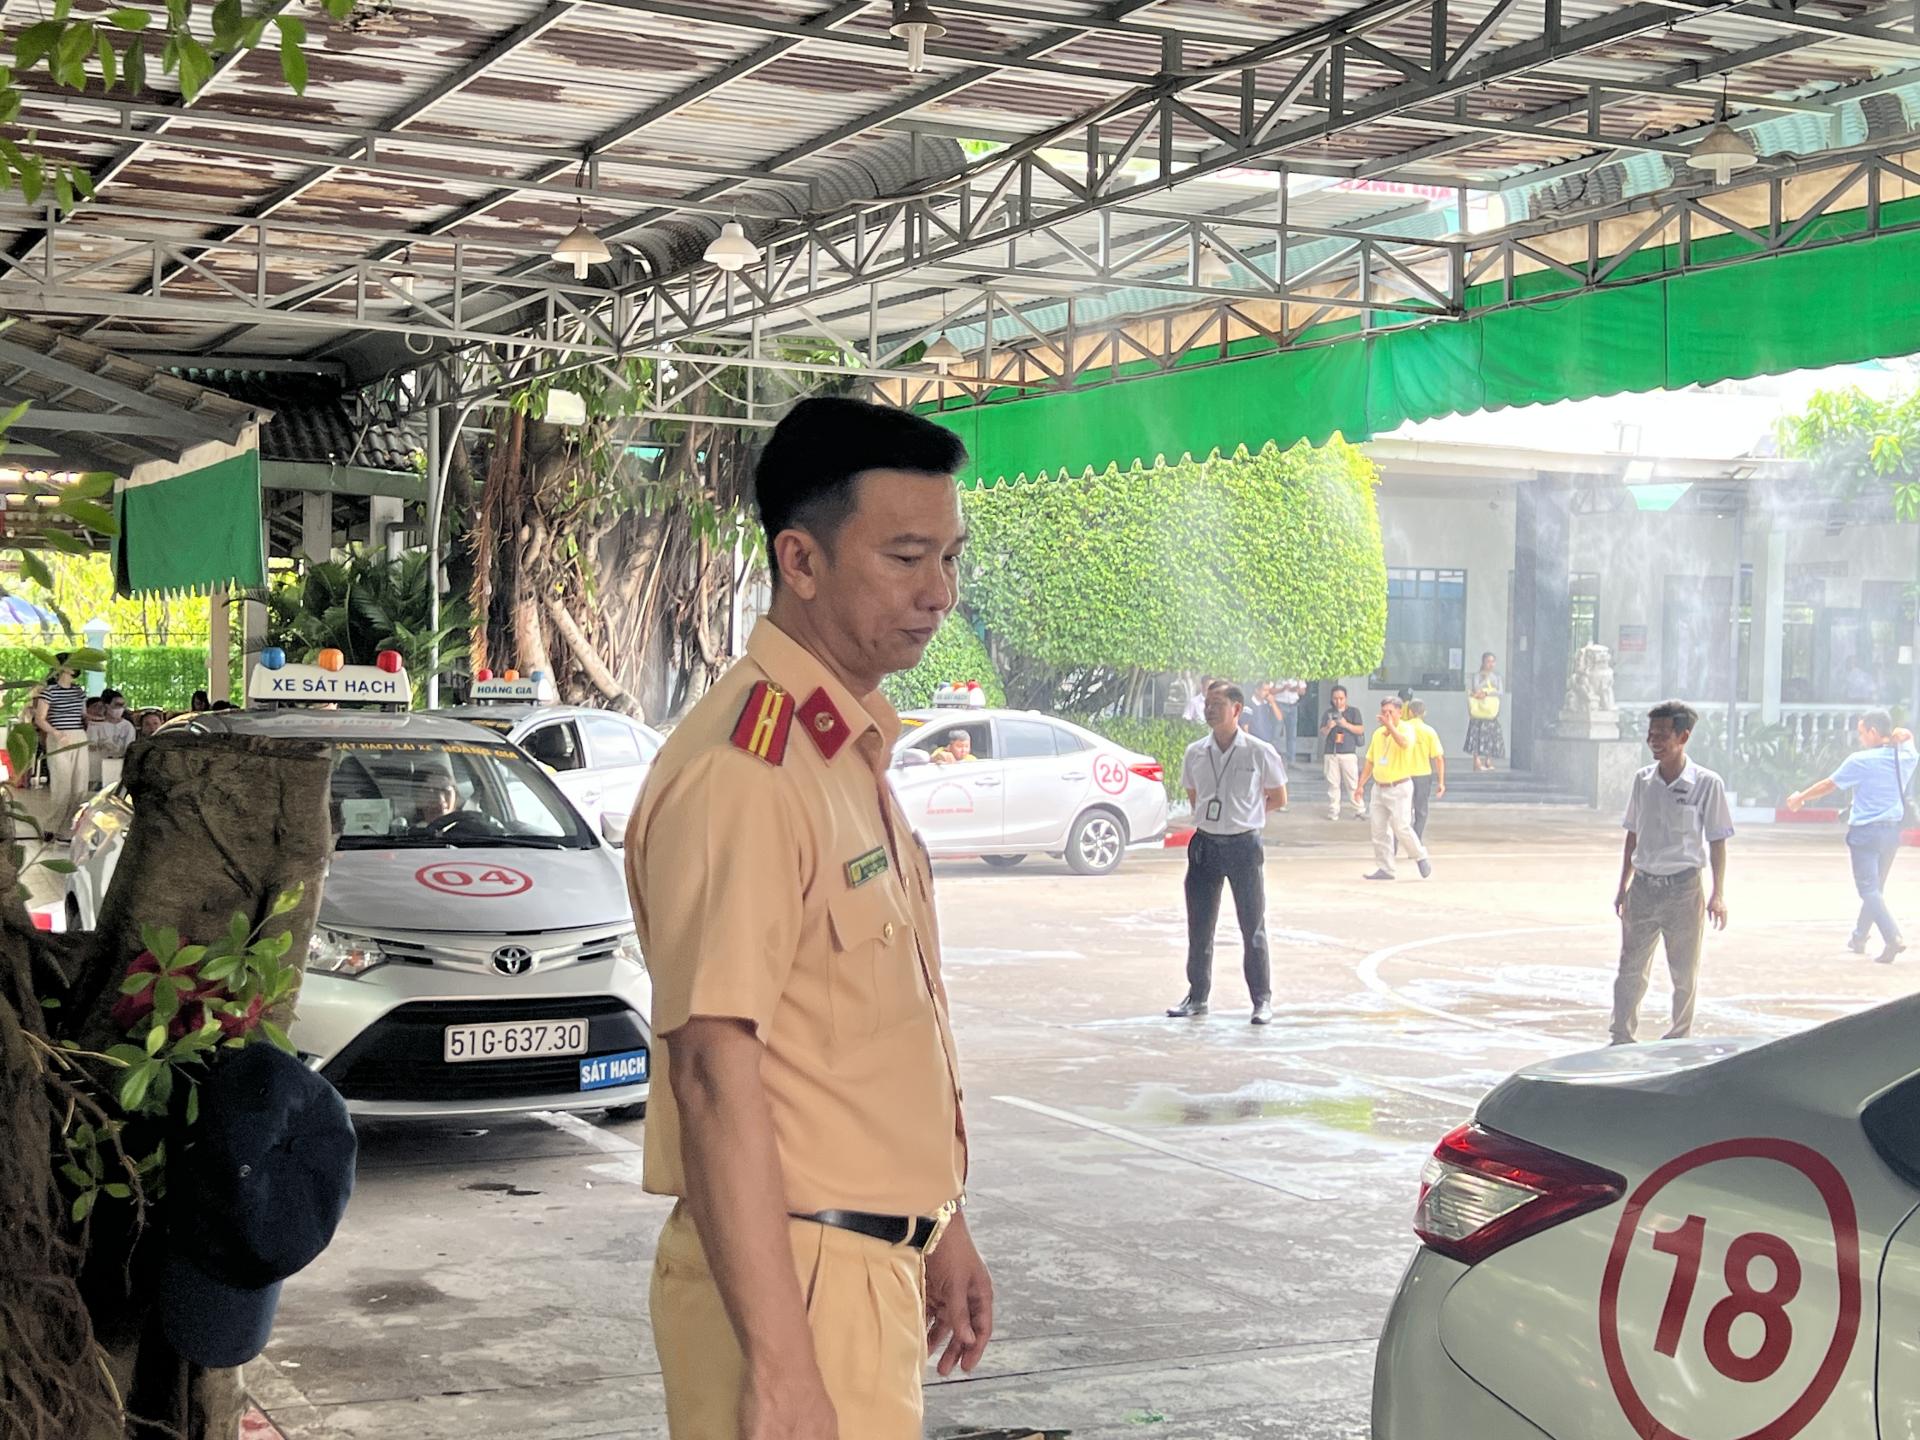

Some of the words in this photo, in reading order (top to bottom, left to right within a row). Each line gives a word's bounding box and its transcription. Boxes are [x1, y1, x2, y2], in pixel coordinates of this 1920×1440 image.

[272, 678, 296, 692] XE
[302, 676, 338, 692] SÁT
[345, 680, 396, 696] HẠCH
[515, 686, 532, 695] GIA
[1100, 763, 1124, 783] 26
[432, 869, 517, 885] 04
[451, 1024, 581, 1056] 51G-637.30
[581, 1060, 607, 1084] SÁT
[610, 1055, 646, 1081] HẠCH
[1652, 1213, 1803, 1383] 18
